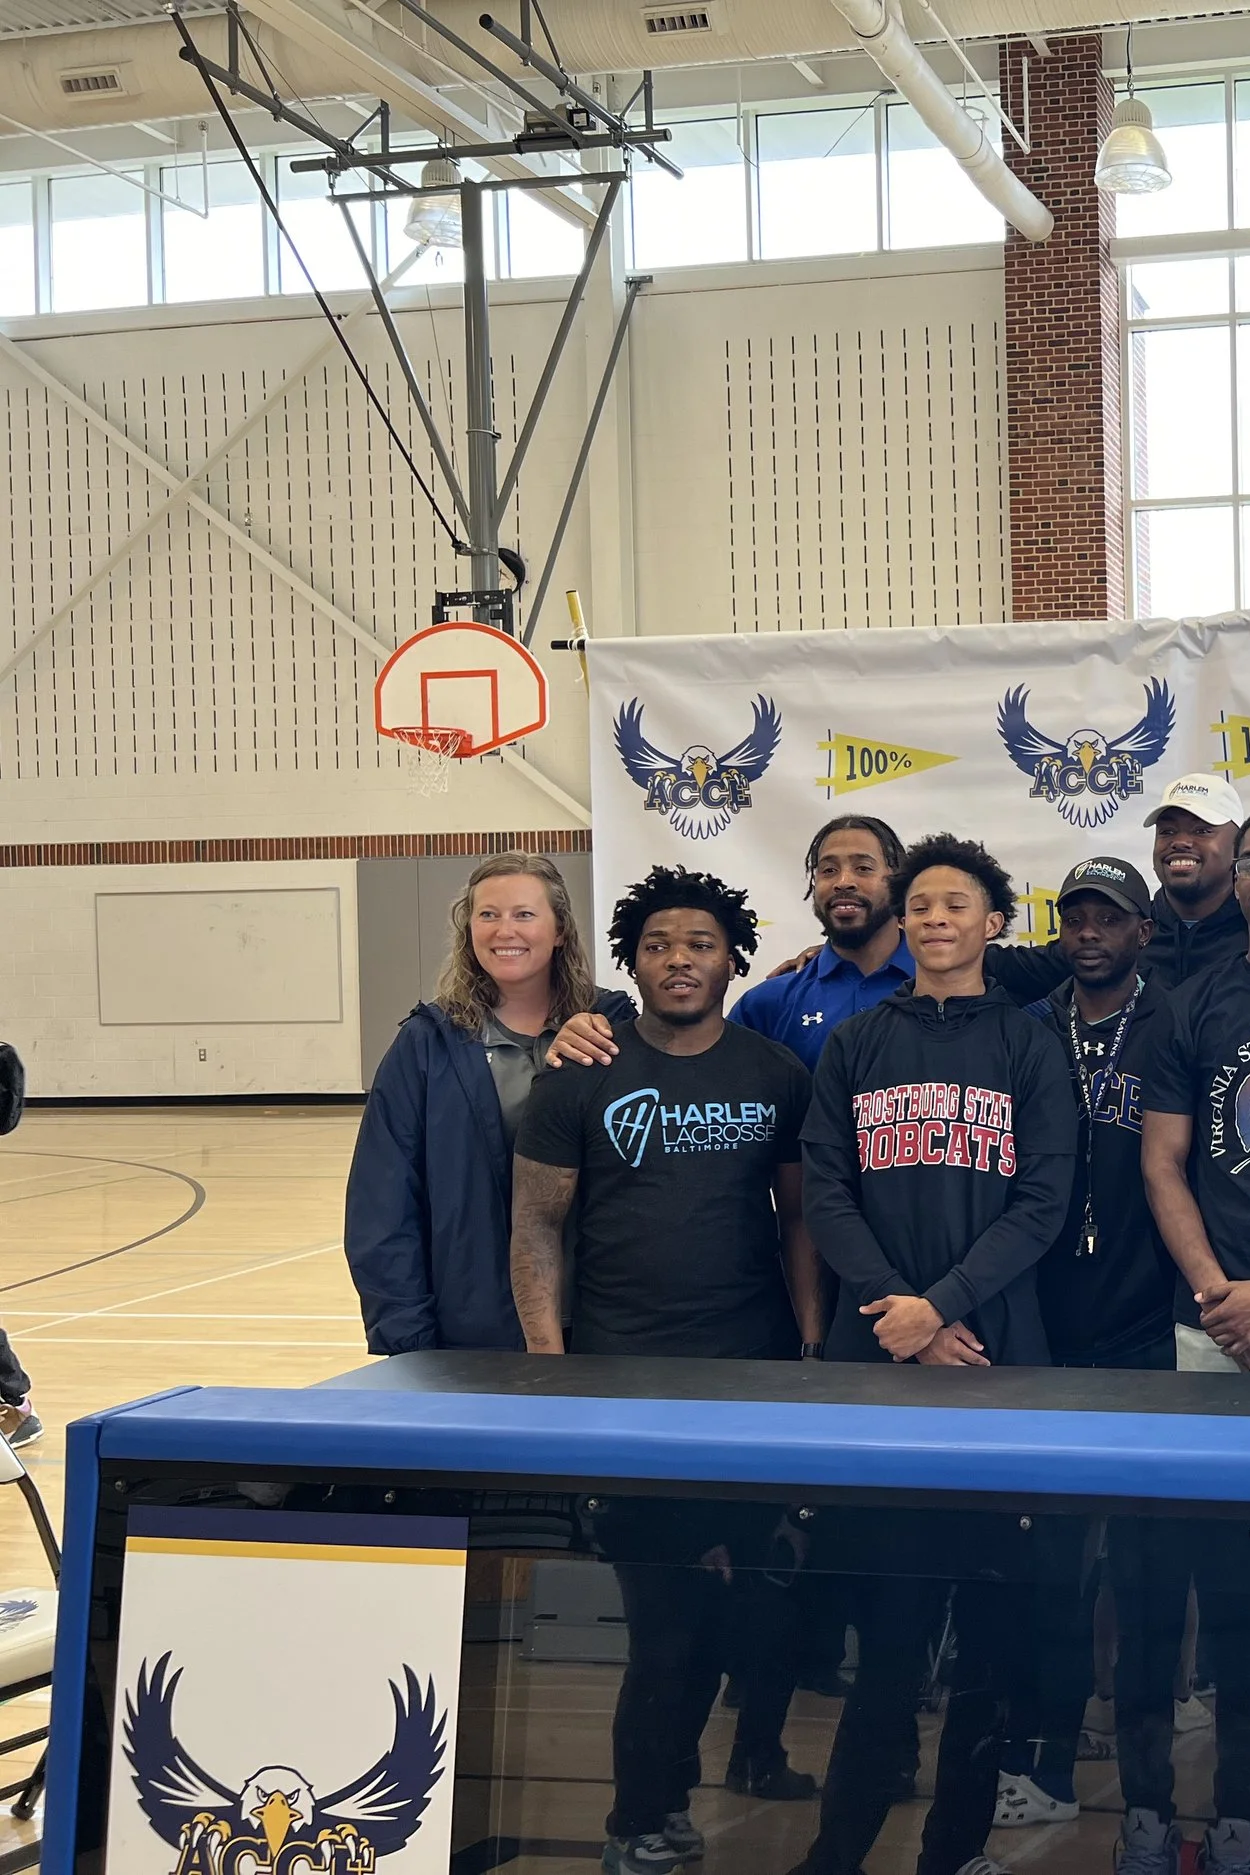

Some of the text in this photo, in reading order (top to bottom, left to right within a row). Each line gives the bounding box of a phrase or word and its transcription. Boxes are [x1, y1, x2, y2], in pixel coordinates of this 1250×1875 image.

[846, 745, 912, 781] 100%
[644, 777, 752, 814] ACCE
[1029, 762, 1144, 801] ACCE
[1177, 784, 1209, 793] HARLEM
[1088, 863, 1126, 879] HARLEM
[1070, 1020, 1082, 1060] RAVENS
[1109, 1016, 1128, 1057] RAVENS
[660, 1102, 776, 1127] HARLEM
[1209, 1065, 1239, 1159] VIRGINIA
[662, 1124, 776, 1146] LACROSSE
[664, 1143, 739, 1154] BALTIMORE
